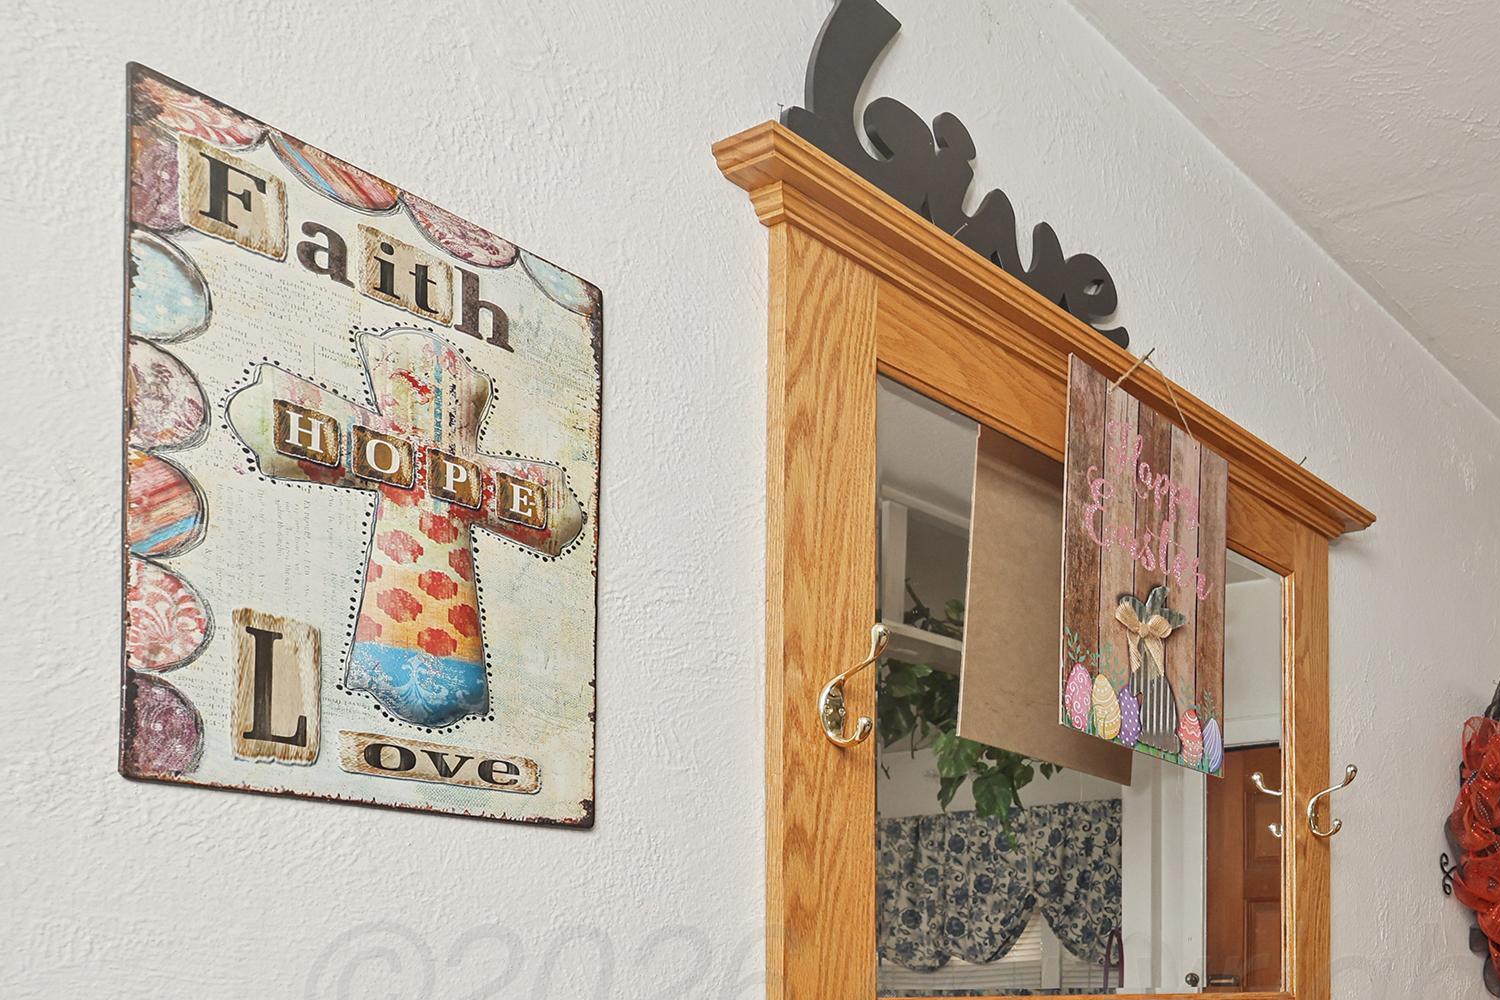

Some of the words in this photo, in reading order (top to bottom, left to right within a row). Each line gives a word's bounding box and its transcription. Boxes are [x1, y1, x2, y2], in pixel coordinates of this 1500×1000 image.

[198, 151, 515, 353] Faith
[284, 409, 537, 519] HOPE
[1106, 418, 1201, 533] Happy
[1084, 465, 1214, 601] Easter
